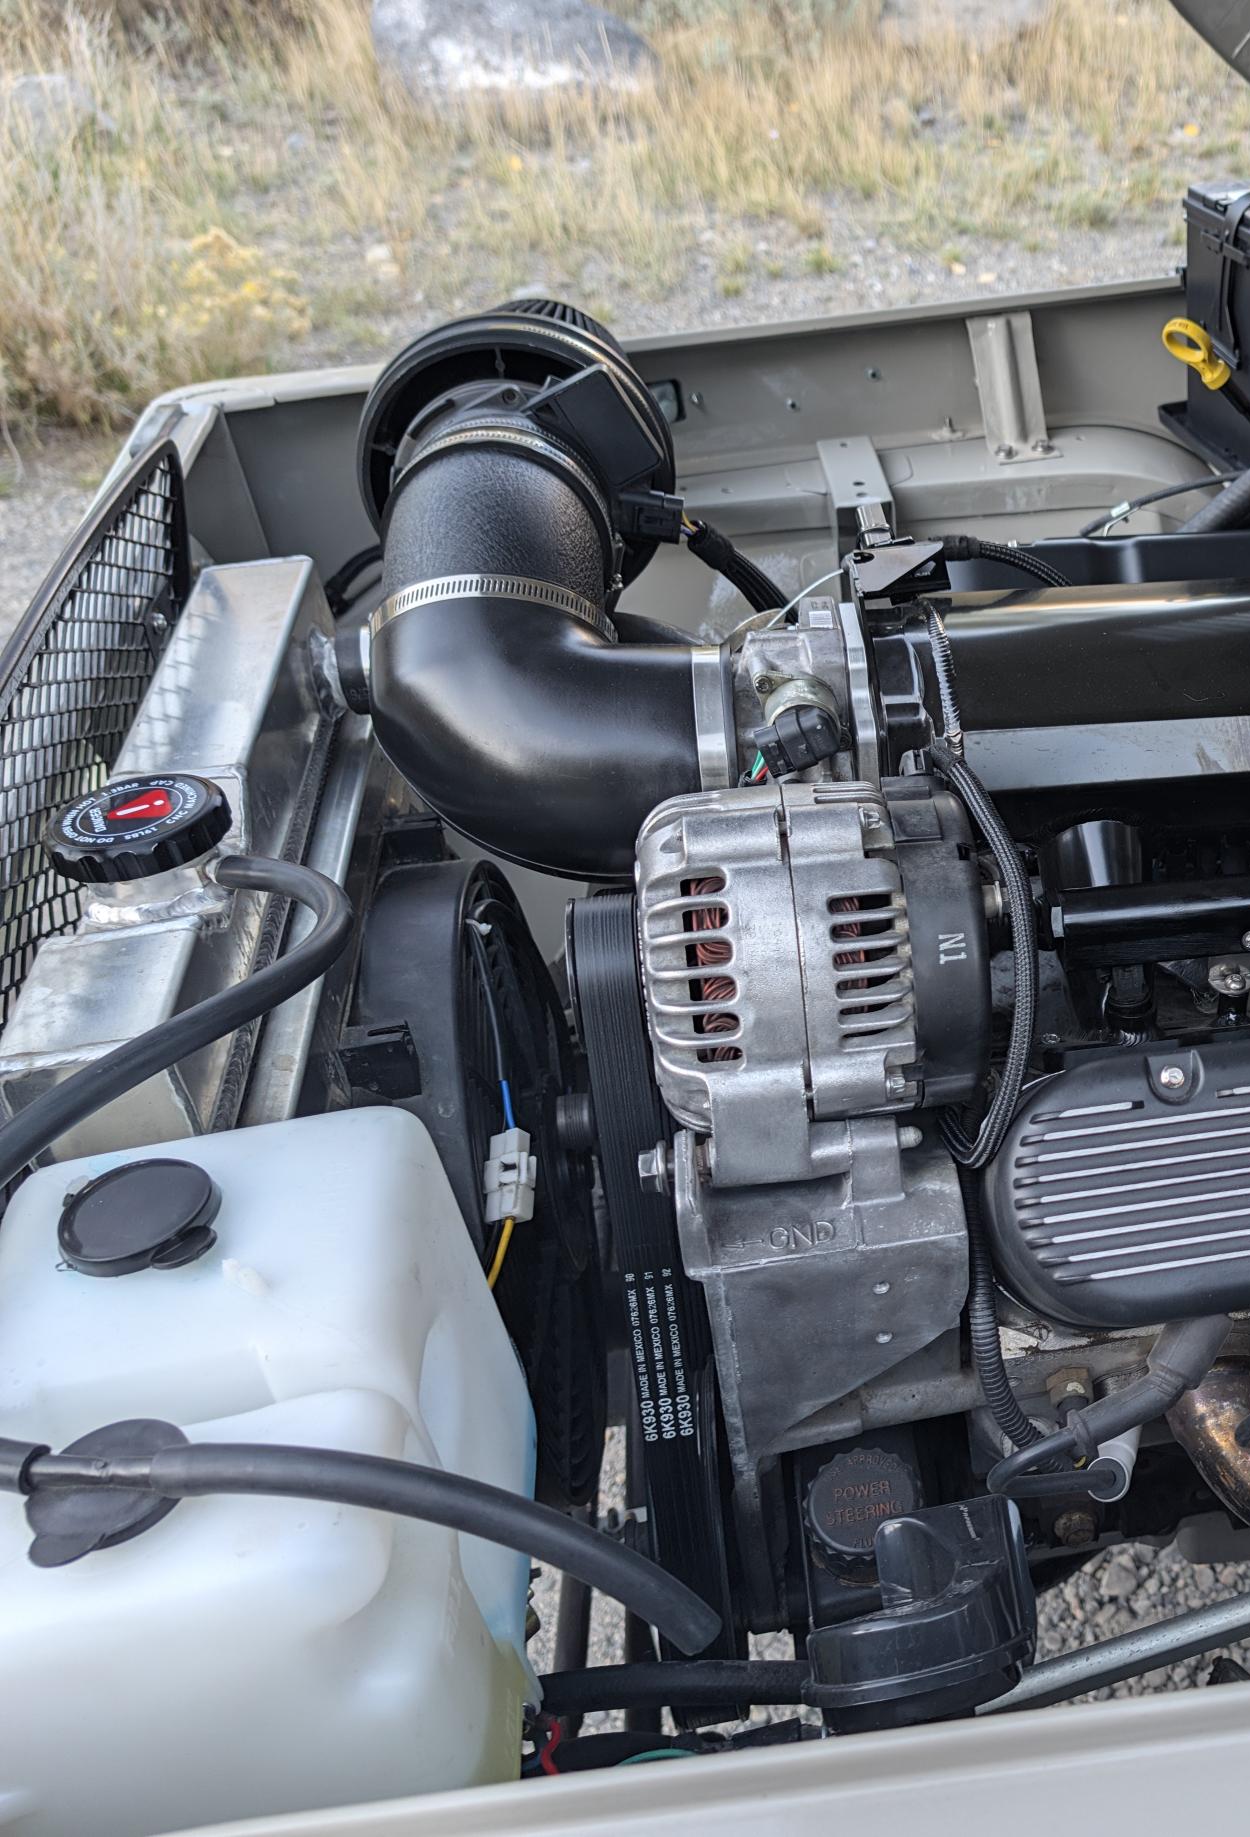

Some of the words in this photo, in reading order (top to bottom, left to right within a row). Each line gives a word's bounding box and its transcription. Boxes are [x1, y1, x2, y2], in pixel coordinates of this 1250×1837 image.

[76, 797, 96, 810] HOT
[174, 782, 198, 808] MACHINED
[62, 809, 79, 826] WHEN
[89, 807, 107, 833] DANGER
[165, 810, 188, 825] CNC
[62, 826, 78, 839] OPEN
[74, 834, 94, 843] NOT
[769, 1221, 835, 1250] GND
[633, 1329, 645, 1363] MEXICO
[651, 1327, 663, 1360] MEXICO
[670, 1324, 681, 1357] MEXICO
[638, 1363, 646, 1373] IN
[656, 1361, 665, 1371] IN
[674, 1358, 682, 1367] IN
[639, 1374, 650, 1399] MADE
[657, 1372, 667, 1396] MADE
[675, 1369, 686, 1393] MADE
[640, 1400, 658, 1442] 6K930
[658, 1397, 676, 1440] 6K930
[676, 1395, 694, 1437] 6K930
[832, 1480, 891, 1501] POWER
[824, 1500, 904, 1528] STEERING
